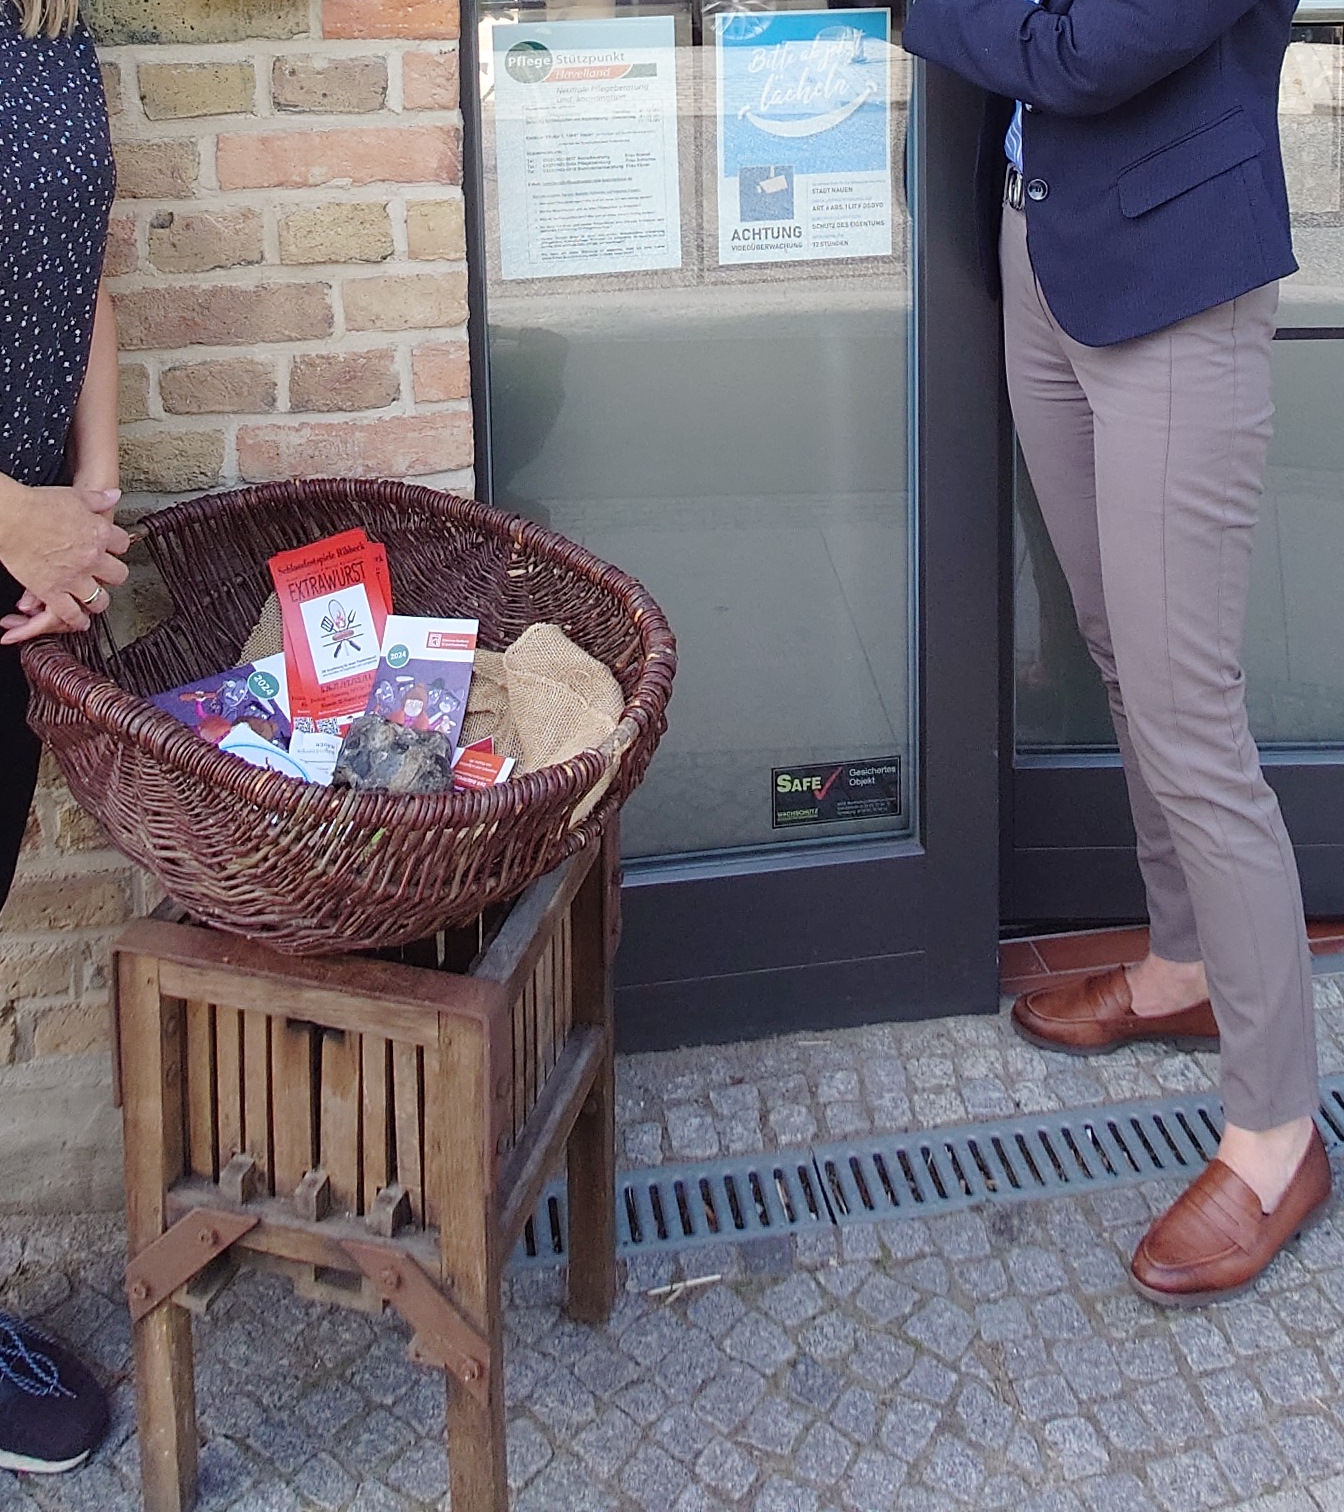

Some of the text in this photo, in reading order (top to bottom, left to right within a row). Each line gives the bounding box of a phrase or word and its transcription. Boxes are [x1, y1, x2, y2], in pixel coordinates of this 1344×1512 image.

[508, 52, 625, 68] Pflege Stützpunkt
[748, 44, 796, 73] Bitte
[800, 35, 821, 61] ab
[556, 68, 611, 80] Havelland
[590, 84, 650, 92] Pflegeberatung
[760, 63, 850, 112] lächeln
[556, 96, 572, 104] und
[832, 186, 853, 194] NAUEN
[850, 220, 884, 228] EIGENTUMS
[731, 226, 802, 242] ACHTUNG
[731, 242, 803, 252] VIDEOÜBERWACHUNG
[820, 240, 848, 248] STUNDEN
[336, 542, 365, 558] Ribbeck
[288, 560, 366, 602] EXTRAWURST
[390, 650, 407, 660] 2024
[254, 674, 274, 696] 2024
[776, 766, 896, 793] SAFE Gesichertes
[849, 776, 876, 788] Objekt
